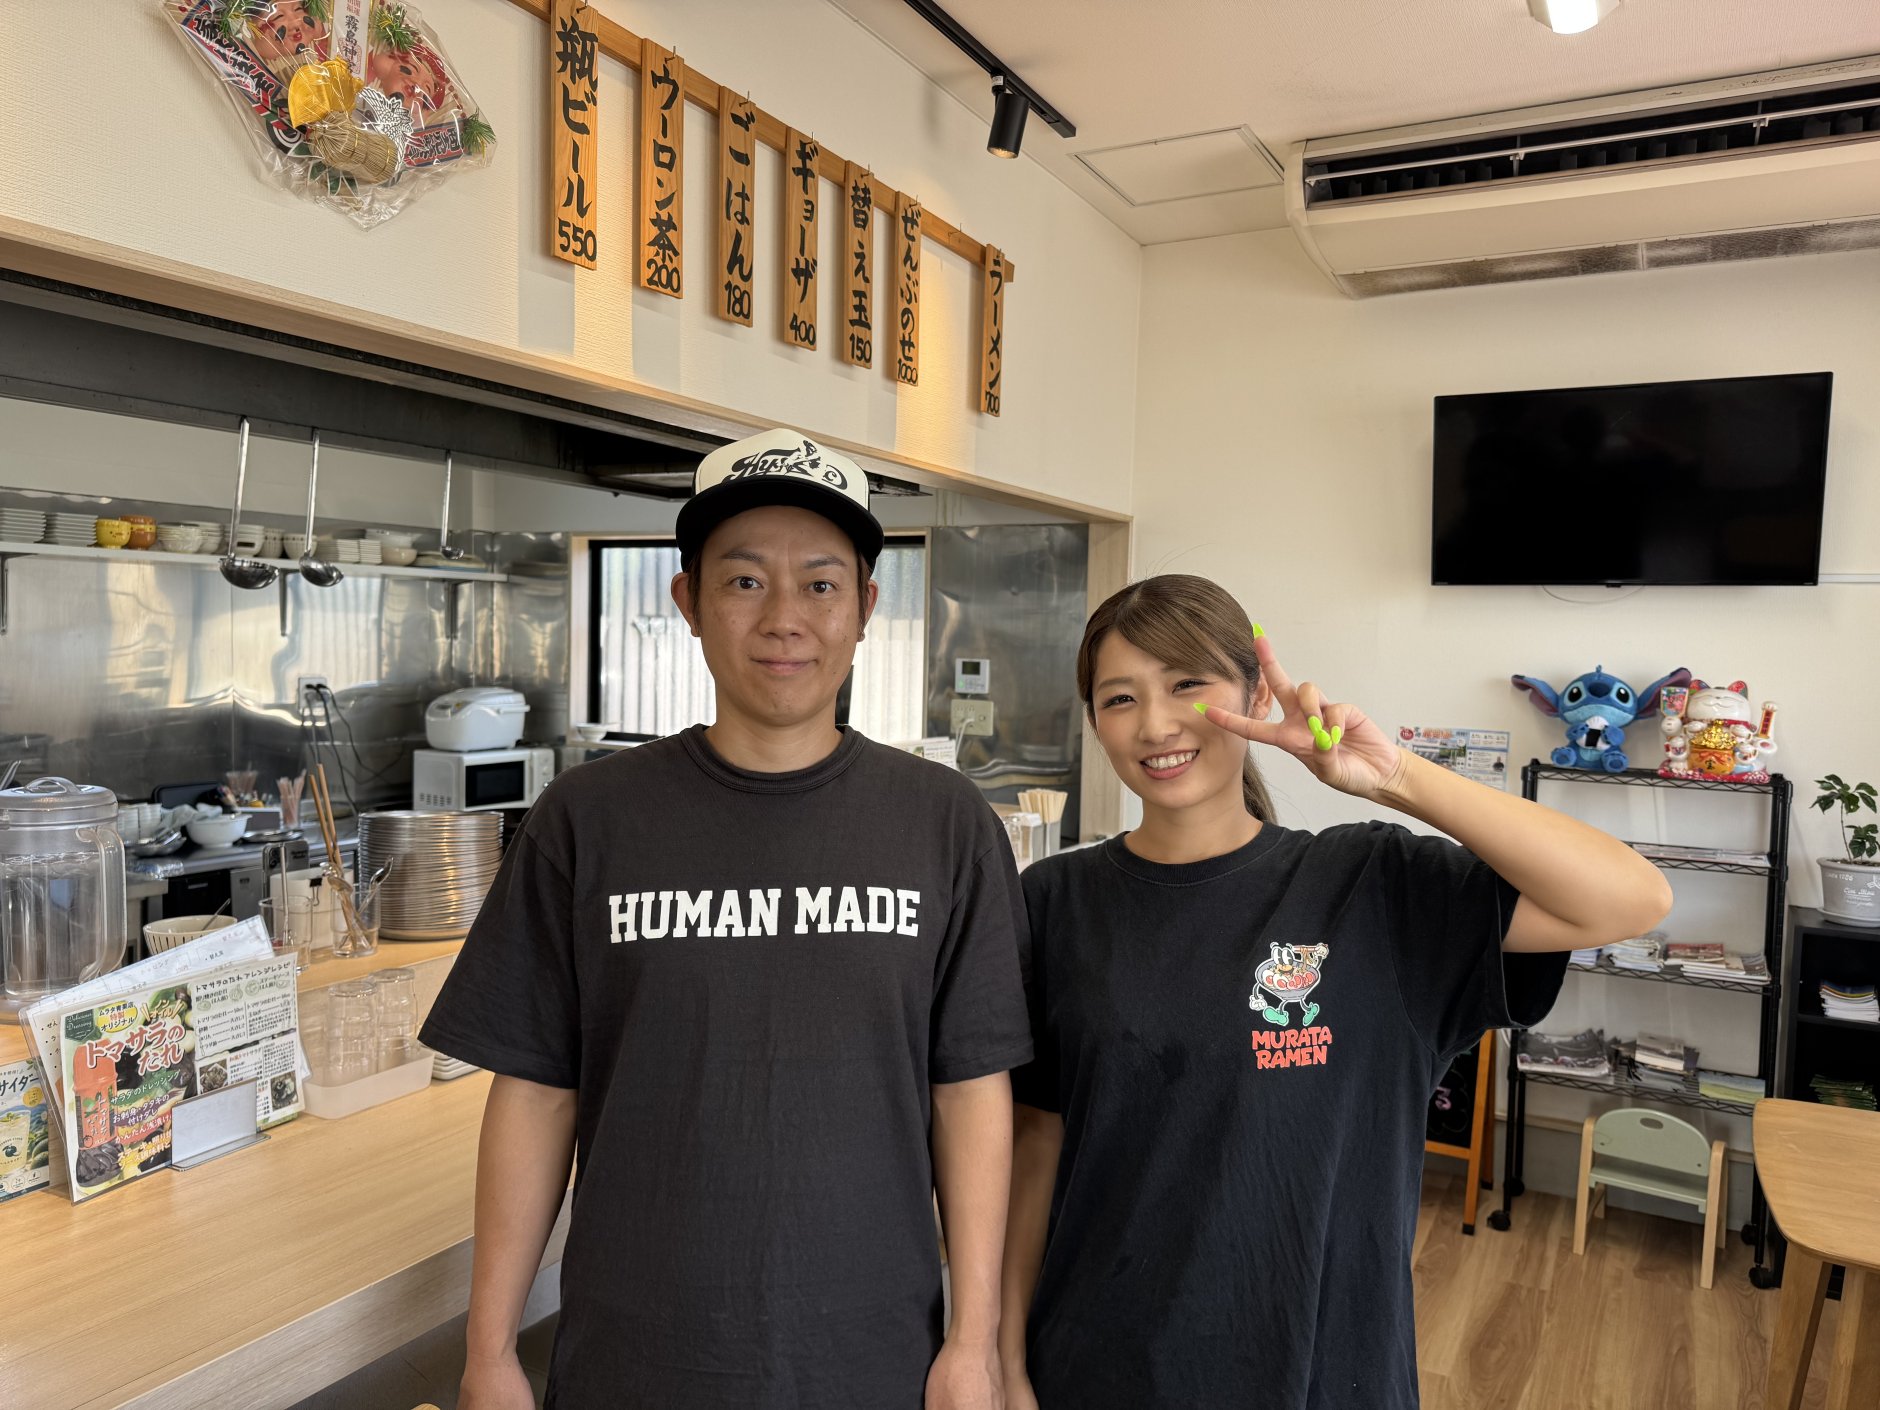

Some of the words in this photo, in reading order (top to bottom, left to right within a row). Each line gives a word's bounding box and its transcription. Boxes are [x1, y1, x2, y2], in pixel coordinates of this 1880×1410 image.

[555, 15, 598, 219] 瓶ビール
[646, 63, 680, 263] ウーロン茶
[558, 217, 597, 262] 550
[791, 139, 819, 303] ギョーザ
[849, 179, 872, 331] 替え玉
[646, 258, 681, 293] 200
[900, 206, 921, 362] ぜんぶのせ
[725, 280, 751, 320] 180
[789, 312, 816, 346] 400
[988, 255, 1002, 391] ラーメン
[850, 332, 872, 364] 150
[897, 358, 918, 385] 1000
[985, 390, 1000, 414] 700
[608, 888, 782, 944] HUMAN
[794, 886, 921, 937] MADE
[100, 1016, 135, 1032] オリジナル
[1251, 1026, 1333, 1051] MURATA
[86, 1021, 185, 1068] トマサラの
[1255, 1045, 1328, 1070] RAMEN
[110, 1069, 181, 1104] サラダのドレッシング
